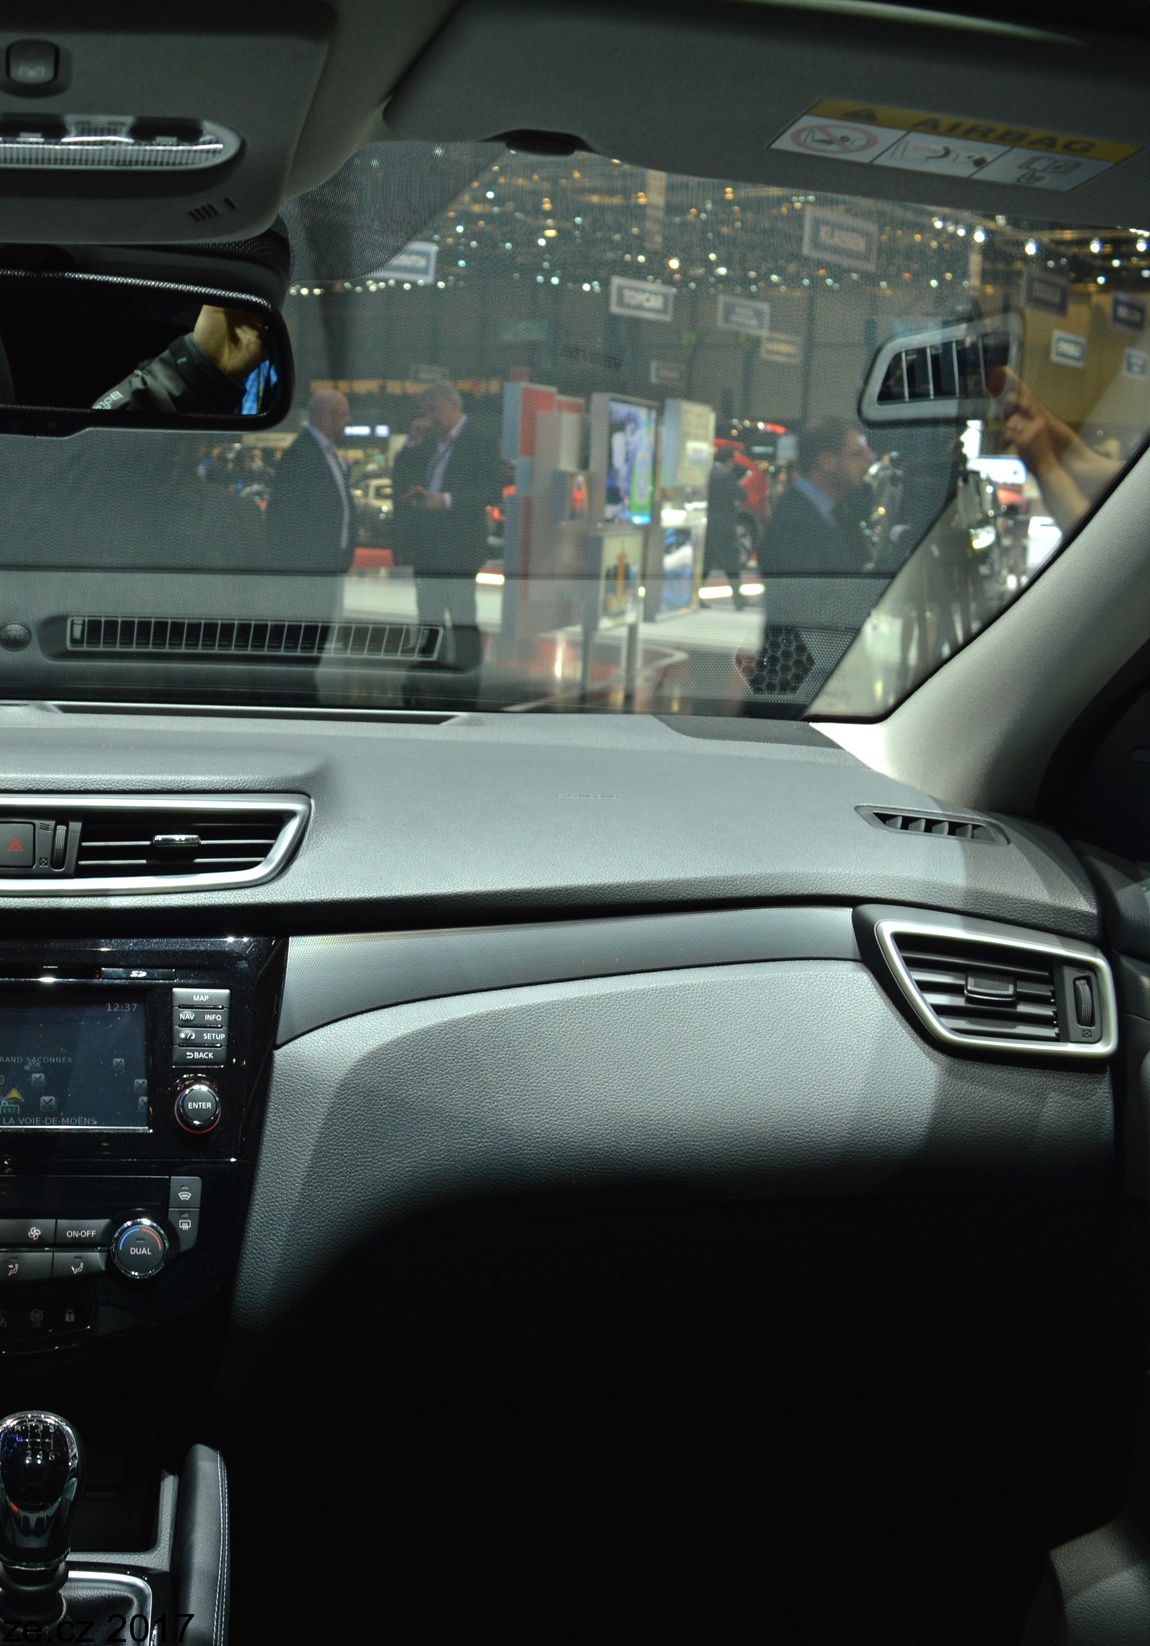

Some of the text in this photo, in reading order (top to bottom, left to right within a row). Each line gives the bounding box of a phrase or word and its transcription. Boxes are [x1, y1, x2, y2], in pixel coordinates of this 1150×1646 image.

[911, 116, 1097, 152] AIRBAG
[192, 994, 210, 1002] MAP
[106, 1002, 138, 1012] 12:37
[204, 1013, 222, 1021] INFO
[203, 1032, 226, 1040] SETUP
[194, 1051, 214, 1059] BACK
[187, 1101, 212, 1109] ENTER
[2, 1117, 16, 1125] LA
[66, 1229, 97, 1238] ON-OFF
[129, 1247, 152, 1255] DUAL
